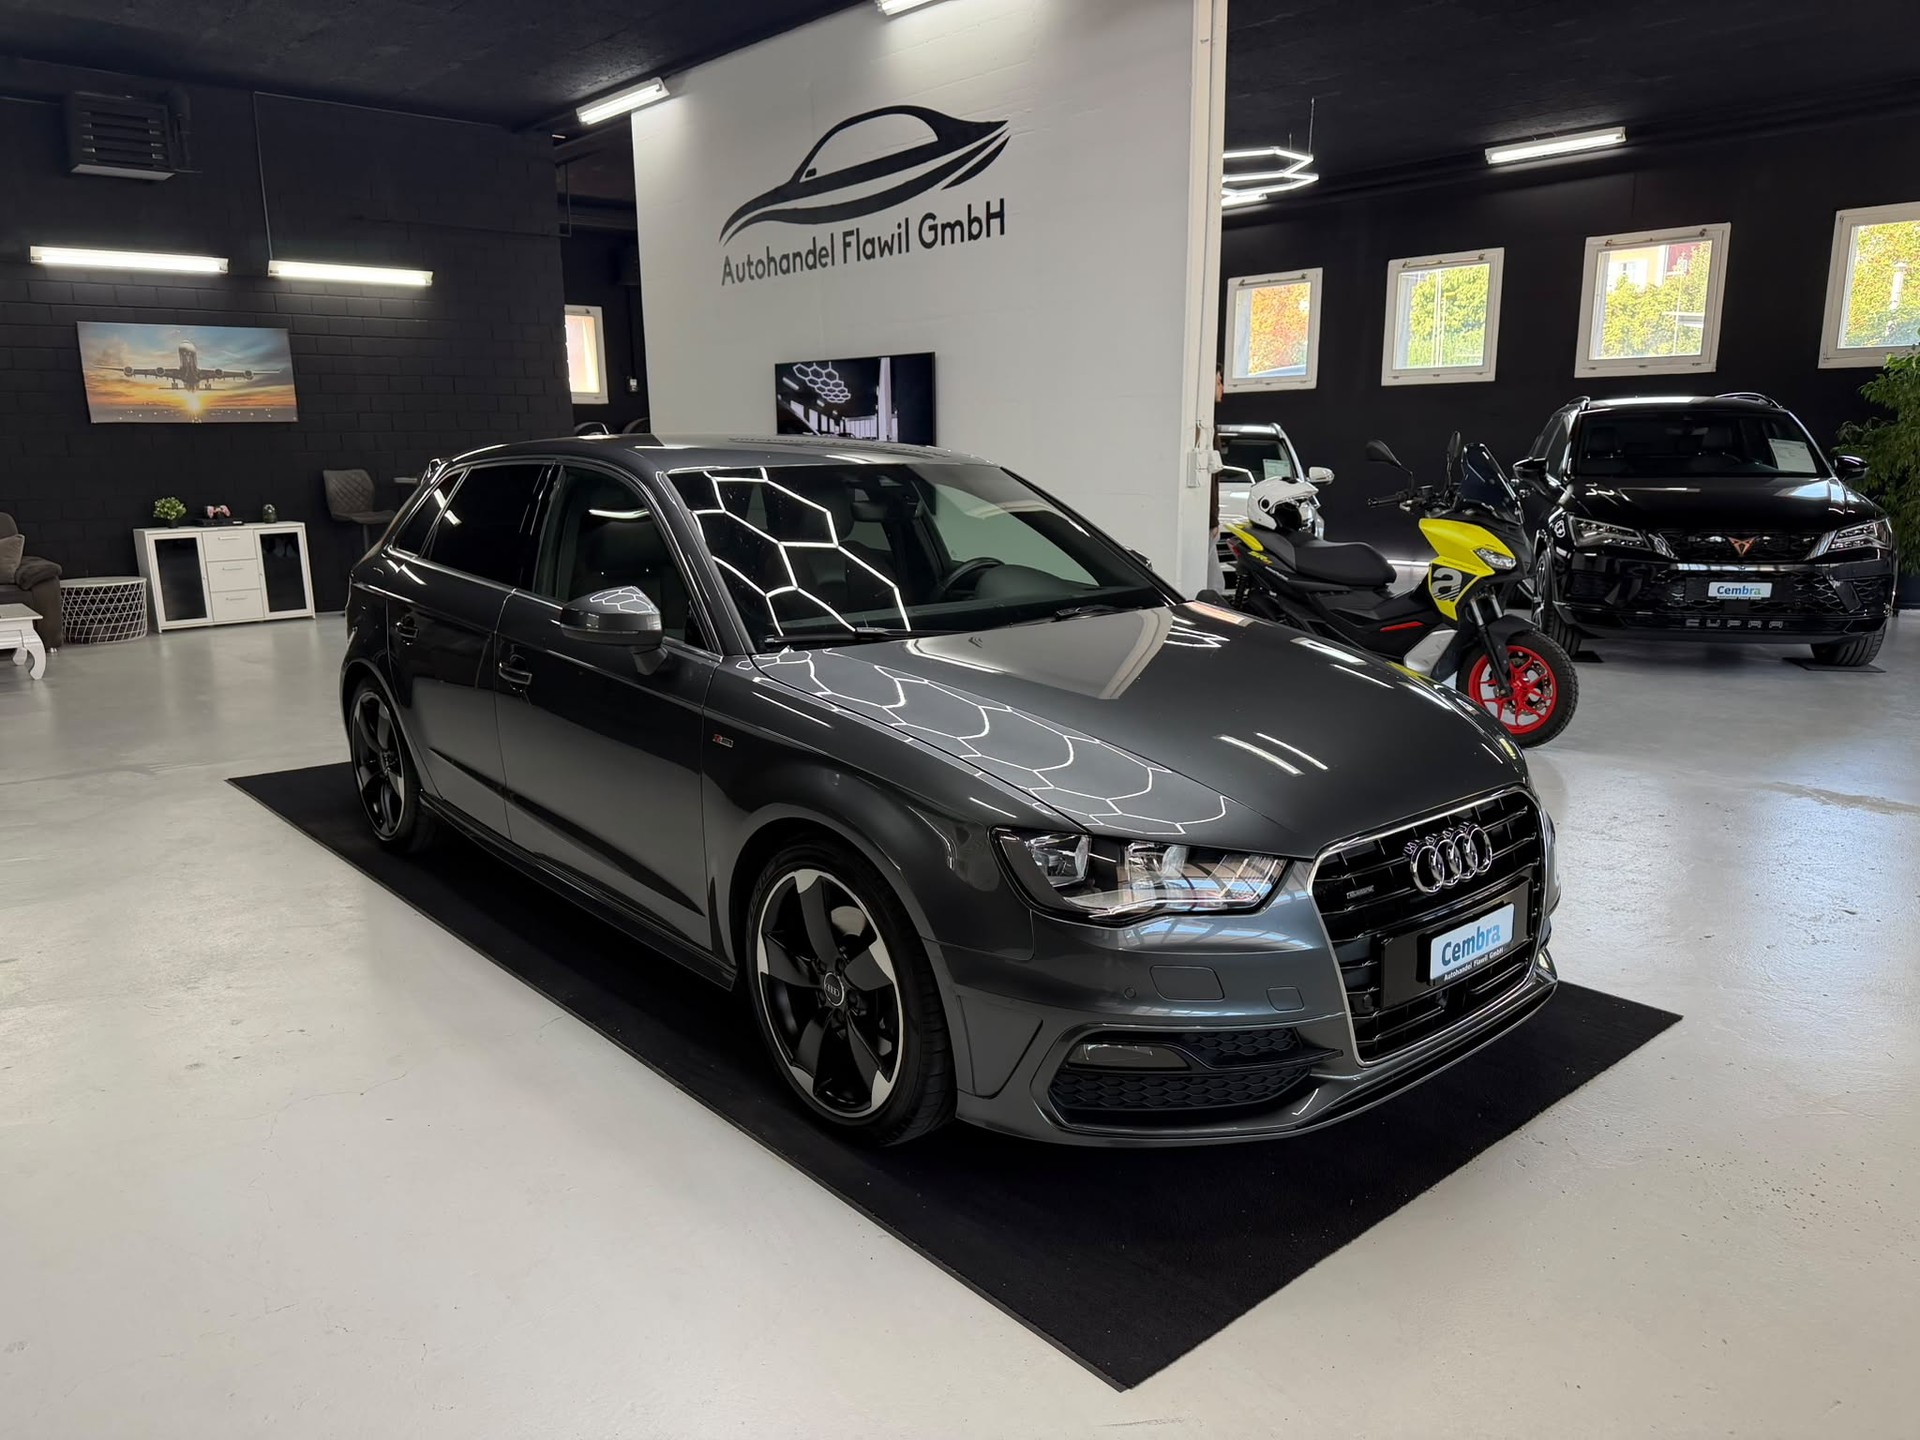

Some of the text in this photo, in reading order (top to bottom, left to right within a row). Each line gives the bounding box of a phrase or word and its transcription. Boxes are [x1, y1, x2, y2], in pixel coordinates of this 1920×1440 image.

[721, 198, 1005, 286] Autohandel Flawil GmbH
[1717, 585, 1761, 595] Cembra
[1685, 619, 1783, 628] CUPRA
[1442, 924, 1500, 966] Cembra
[1444, 947, 1504, 981] Autohandel Flawil GmbH
